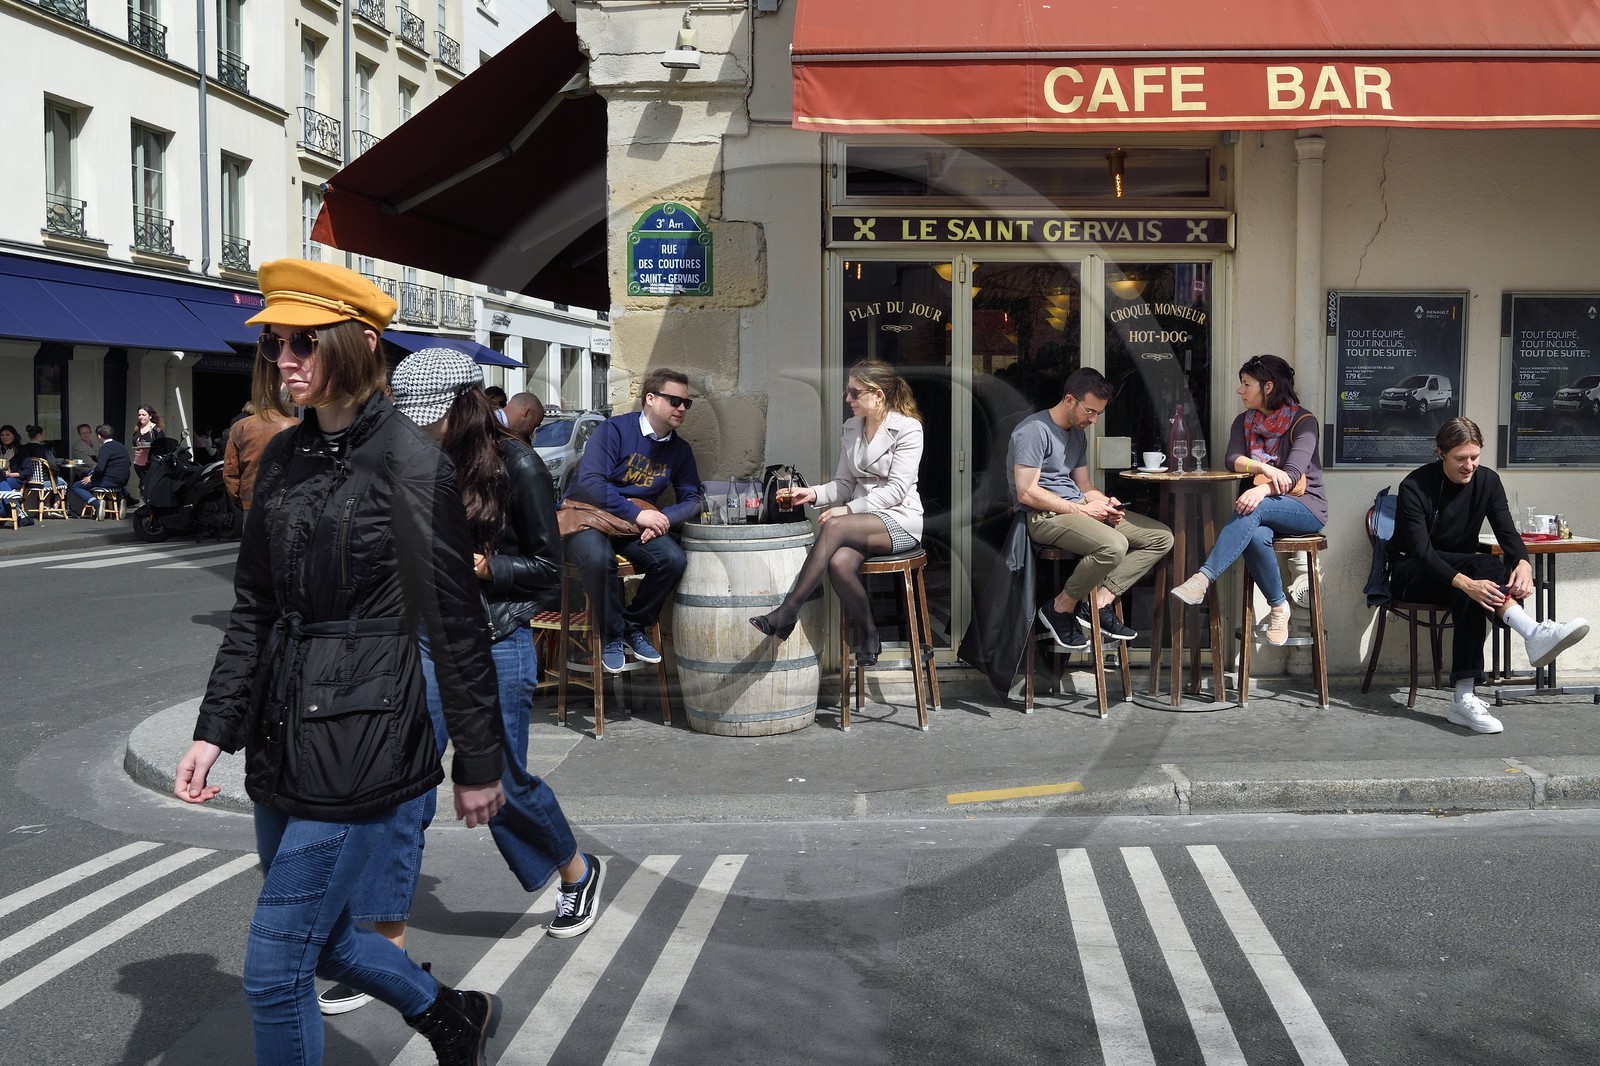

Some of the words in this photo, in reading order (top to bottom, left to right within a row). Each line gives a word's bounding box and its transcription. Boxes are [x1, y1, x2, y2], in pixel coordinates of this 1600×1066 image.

[1043, 66, 1207, 114] CAFE
[1266, 65, 1394, 111] BAR
[901, 219, 937, 241] LE
[947, 219, 1033, 242] SAINT
[1043, 219, 1163, 242] GERVAIS
[661, 244, 678, 255] RUE
[638, 259, 654, 269] DES
[658, 259, 701, 269] COUTURES
[848, 302, 881, 322] PLAT
[886, 301, 904, 314] DU
[909, 302, 942, 322] JOUR
[1110, 303, 1152, 323] CROQUE
[1154, 302, 1207, 325] MONSIEUR
[1128, 330, 1188, 343] HOT-DOG
[1346, 330, 1370, 338] TOUT
[1372, 328, 1406, 339] ÉQUIPÉ,
[1521, 331, 1545, 339] TOUT
[1546, 329, 1580, 340] ÉQUIPÉ,
[1346, 340, 1370, 348] TOUT
[1372, 340, 1405, 349] INCLUS,
[1521, 340, 1545, 348] TOUT
[1546, 340, 1579, 349] INCLUS,
[1345, 349, 1371, 357] TOUT
[1373, 349, 1385, 357] DE
[1520, 350, 1545, 358] TOUT
[1547, 350, 1559, 358] DE
